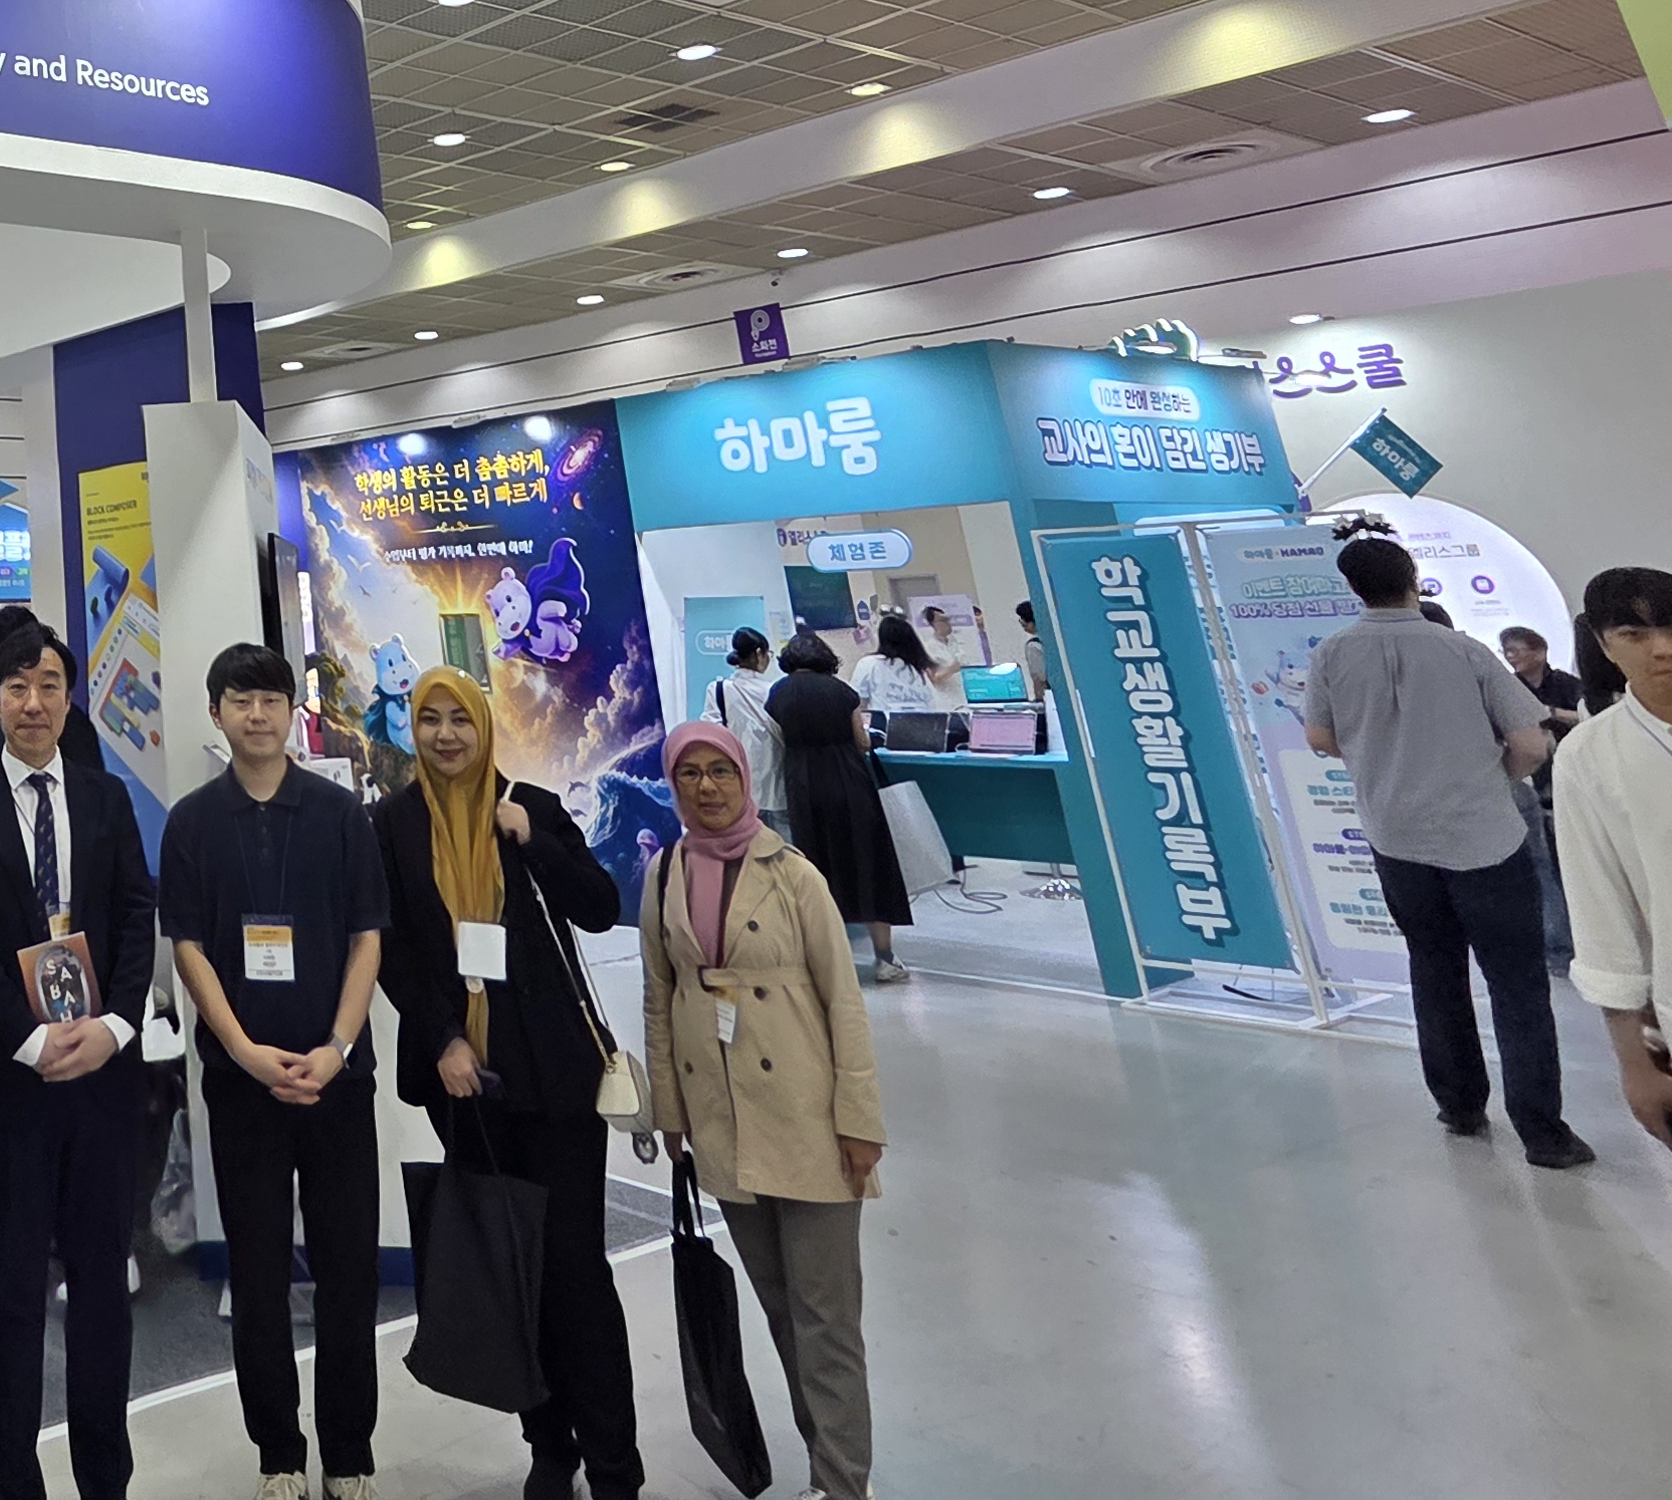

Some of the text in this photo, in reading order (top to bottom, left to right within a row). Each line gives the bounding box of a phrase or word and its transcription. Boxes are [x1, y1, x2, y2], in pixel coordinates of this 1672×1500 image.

[13, 54, 68, 83] and
[75, 57, 210, 107] Resources
[1098, 386, 1192, 413] 10초 안에 완성하는
[1038, 420, 1265, 475] 교사의 혼이 담긴 생기부
[354, 467, 397, 496] 학생의
[400, 462, 450, 490] 활동은
[453, 459, 470, 483] 더
[86, 505, 105, 516] BLOCK
[360, 478, 548, 522] 선생님의 퇴근은 더 빠르게
[828, 541, 887, 561] 체험존
[1230, 603, 1270, 618] 100%
[1091, 556, 1232, 940] 학교생활기록부
